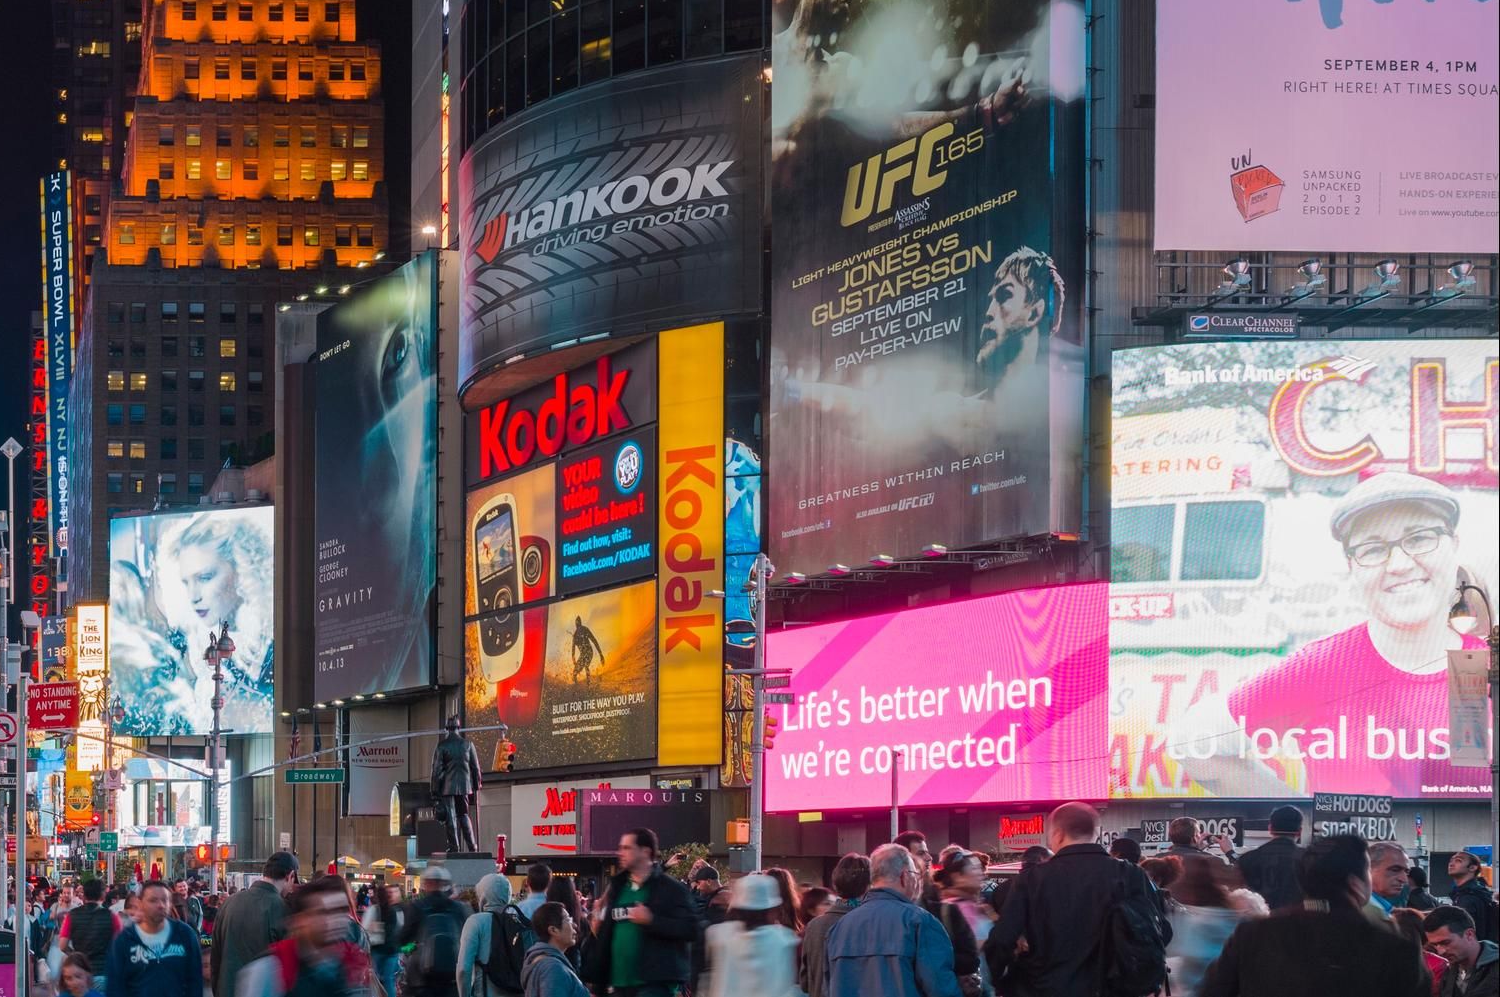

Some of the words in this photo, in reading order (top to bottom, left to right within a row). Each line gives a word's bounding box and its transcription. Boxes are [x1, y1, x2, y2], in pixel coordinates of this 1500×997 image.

[1323, 59, 1420, 73] SEPTEMBER
[1425, 60, 1440, 74] 4,
[1446, 61, 1478, 73] 1PM
[1283, 81, 1328, 94] RIGHT
[1334, 81, 1378, 95] HERE!
[1383, 82, 1402, 95] AT
[1407, 82, 1452, 96] TIMES
[840, 121, 956, 228] UFC
[934, 128, 985, 169] 165
[1302, 170, 1362, 180] SAMSUNG
[1399, 171, 1422, 180] LIVE
[1424, 172, 1485, 181] BROADCAST
[1302, 182, 1362, 192] UNPACKED
[1399, 189, 1454, 199] HANDS-ON
[1302, 206, 1350, 215] EPISODE
[1354, 206, 1361, 216] 2
[532, 221, 606, 257] driving
[612, 201, 729, 235] emotion
[792, 266, 825, 289] LIGHT
[826, 235, 909, 275] HEAVYWEIGHT
[912, 188, 1018, 241] CHAMPIONSHIP
[51, 210, 62, 272] SUPER
[838, 240, 922, 293] JONES
[811, 239, 993, 328] GUSTAFSSON
[52, 275, 64, 327] BOWL
[831, 285, 939, 338] SEPTEMBER
[943, 277, 967, 297] 21
[860, 317, 901, 346] LIVE
[904, 307, 933, 333] ON
[835, 316, 963, 372] PAY-PER-VIEW
[54, 332, 65, 381] XLVIII
[1164, 364, 1218, 386] Bank
[1219, 364, 1241, 382] of
[1243, 364, 1325, 382] America
[56, 397, 66, 422] NY
[481, 354, 632, 478] Kodak
[57, 428, 67, 451] NJ
[563, 456, 602, 488] YOUR
[798, 481, 880, 511] GREATNESS
[885, 465, 945, 489] WITHIN
[950, 450, 1006, 473] REACH
[563, 485, 599, 511] video
[319, 539, 339, 551] SANDRA
[319, 544, 346, 560] BULLOCK
[563, 539, 579, 557] Find
[580, 536, 593, 552] out
[611, 527, 632, 544] visit:
[664, 444, 717, 655] Kodak
[319, 561, 340, 574] GEORGE
[319, 567, 349, 583] CLOONEY
[318, 586, 373, 613] GRAVITY
[81, 633, 101, 644] LION
[80, 645, 103, 658] KING
[319, 657, 344, 672] 10.4.13
[30, 689, 40, 699] NO
[43, 686, 77, 698] STANDING
[552, 703, 569, 715] BUILT
[570, 701, 583, 712] FOR
[583, 700, 596, 711] THE
[596, 697, 611, 709] WAY
[613, 695, 626, 707] YOU
[628, 692, 645, 704] PLAY.
[783, 688, 851, 732] Life's
[860, 684, 949, 725] better
[958, 670, 1052, 714] when
[36, 700, 71, 711] ANYTIME
[1168, 726, 1219, 761] to
[1239, 714, 1347, 761] local
[357, 746, 399, 757] Marriott
[781, 740, 850, 780] we're
[860, 723, 1017, 775] connected
[294, 772, 336, 781] Broadway
[590, 792, 703, 803] MARQUIS
[1421, 785, 1439, 793] Bank
[1315, 803, 1333, 811] best
[1333, 795, 1358, 813] HOT
[1358, 796, 1392, 814] DOGS
[532, 825, 552, 837] NEW
[553, 824, 577, 836] YORK
[999, 815, 1045, 839] Marriott
[1144, 832, 1164, 842] best
